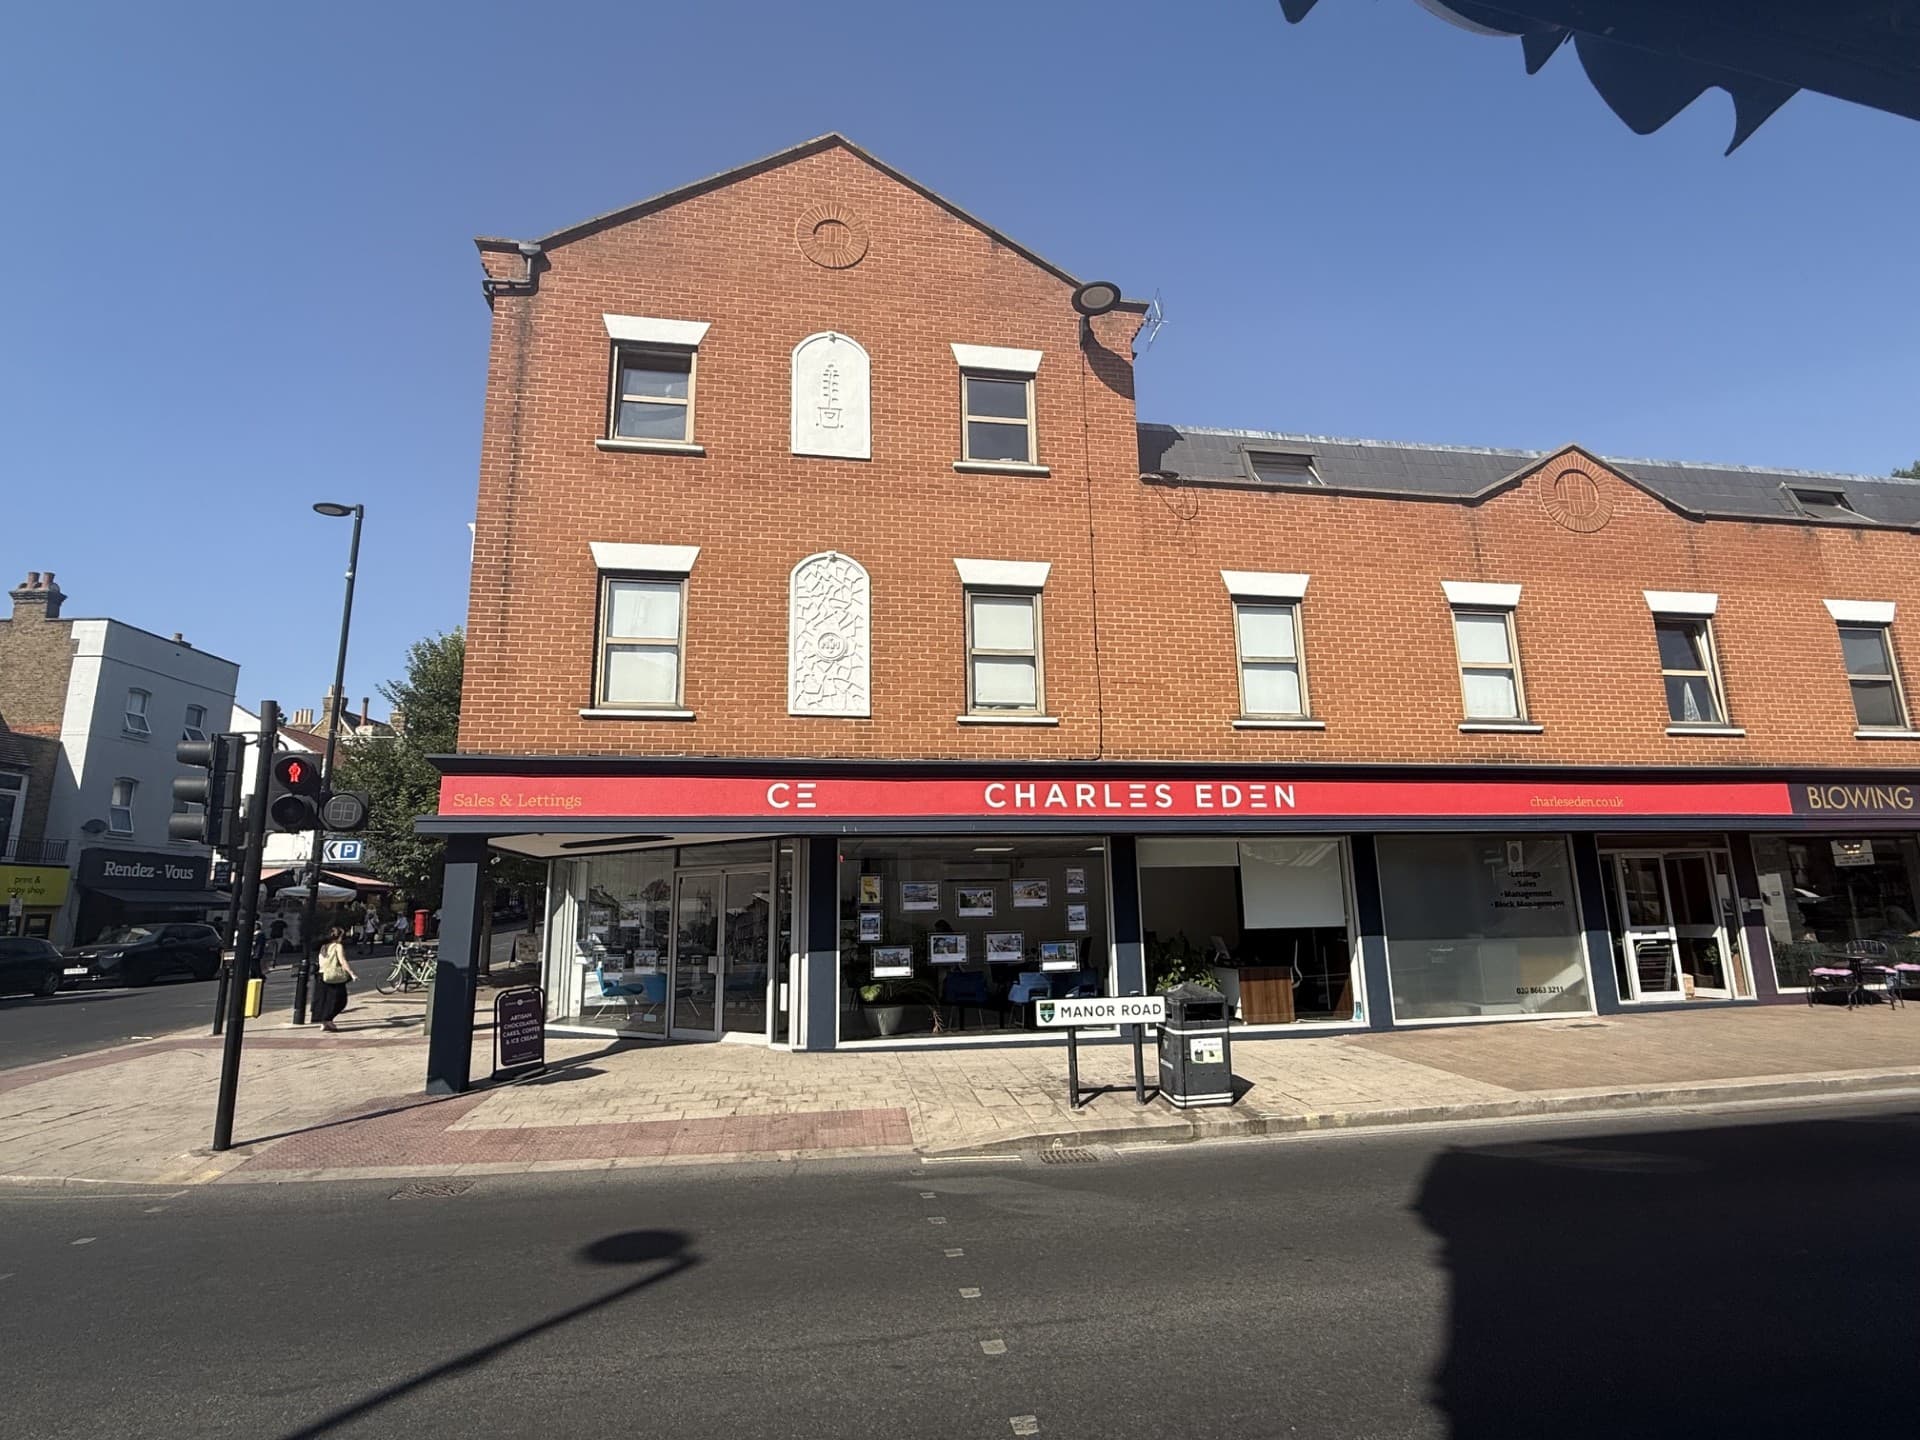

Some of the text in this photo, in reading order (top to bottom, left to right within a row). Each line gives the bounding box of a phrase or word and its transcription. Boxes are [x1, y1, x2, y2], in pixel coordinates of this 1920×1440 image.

[453, 793, 582, 810] Sales & Lettings
[984, 783, 1296, 808] CHARLES EDEN
[1530, 796, 1624, 807] charleseden.co.uk
[1806, 786, 1913, 809] BLOWING
[343, 845, 354, 857] P
[104, 861, 154, 878] Rendez
[165, 864, 194, 880] Vous
[510, 1013, 532, 1021] ARTISAN
[1061, 1003, 1162, 1019] MANOR ROAD
